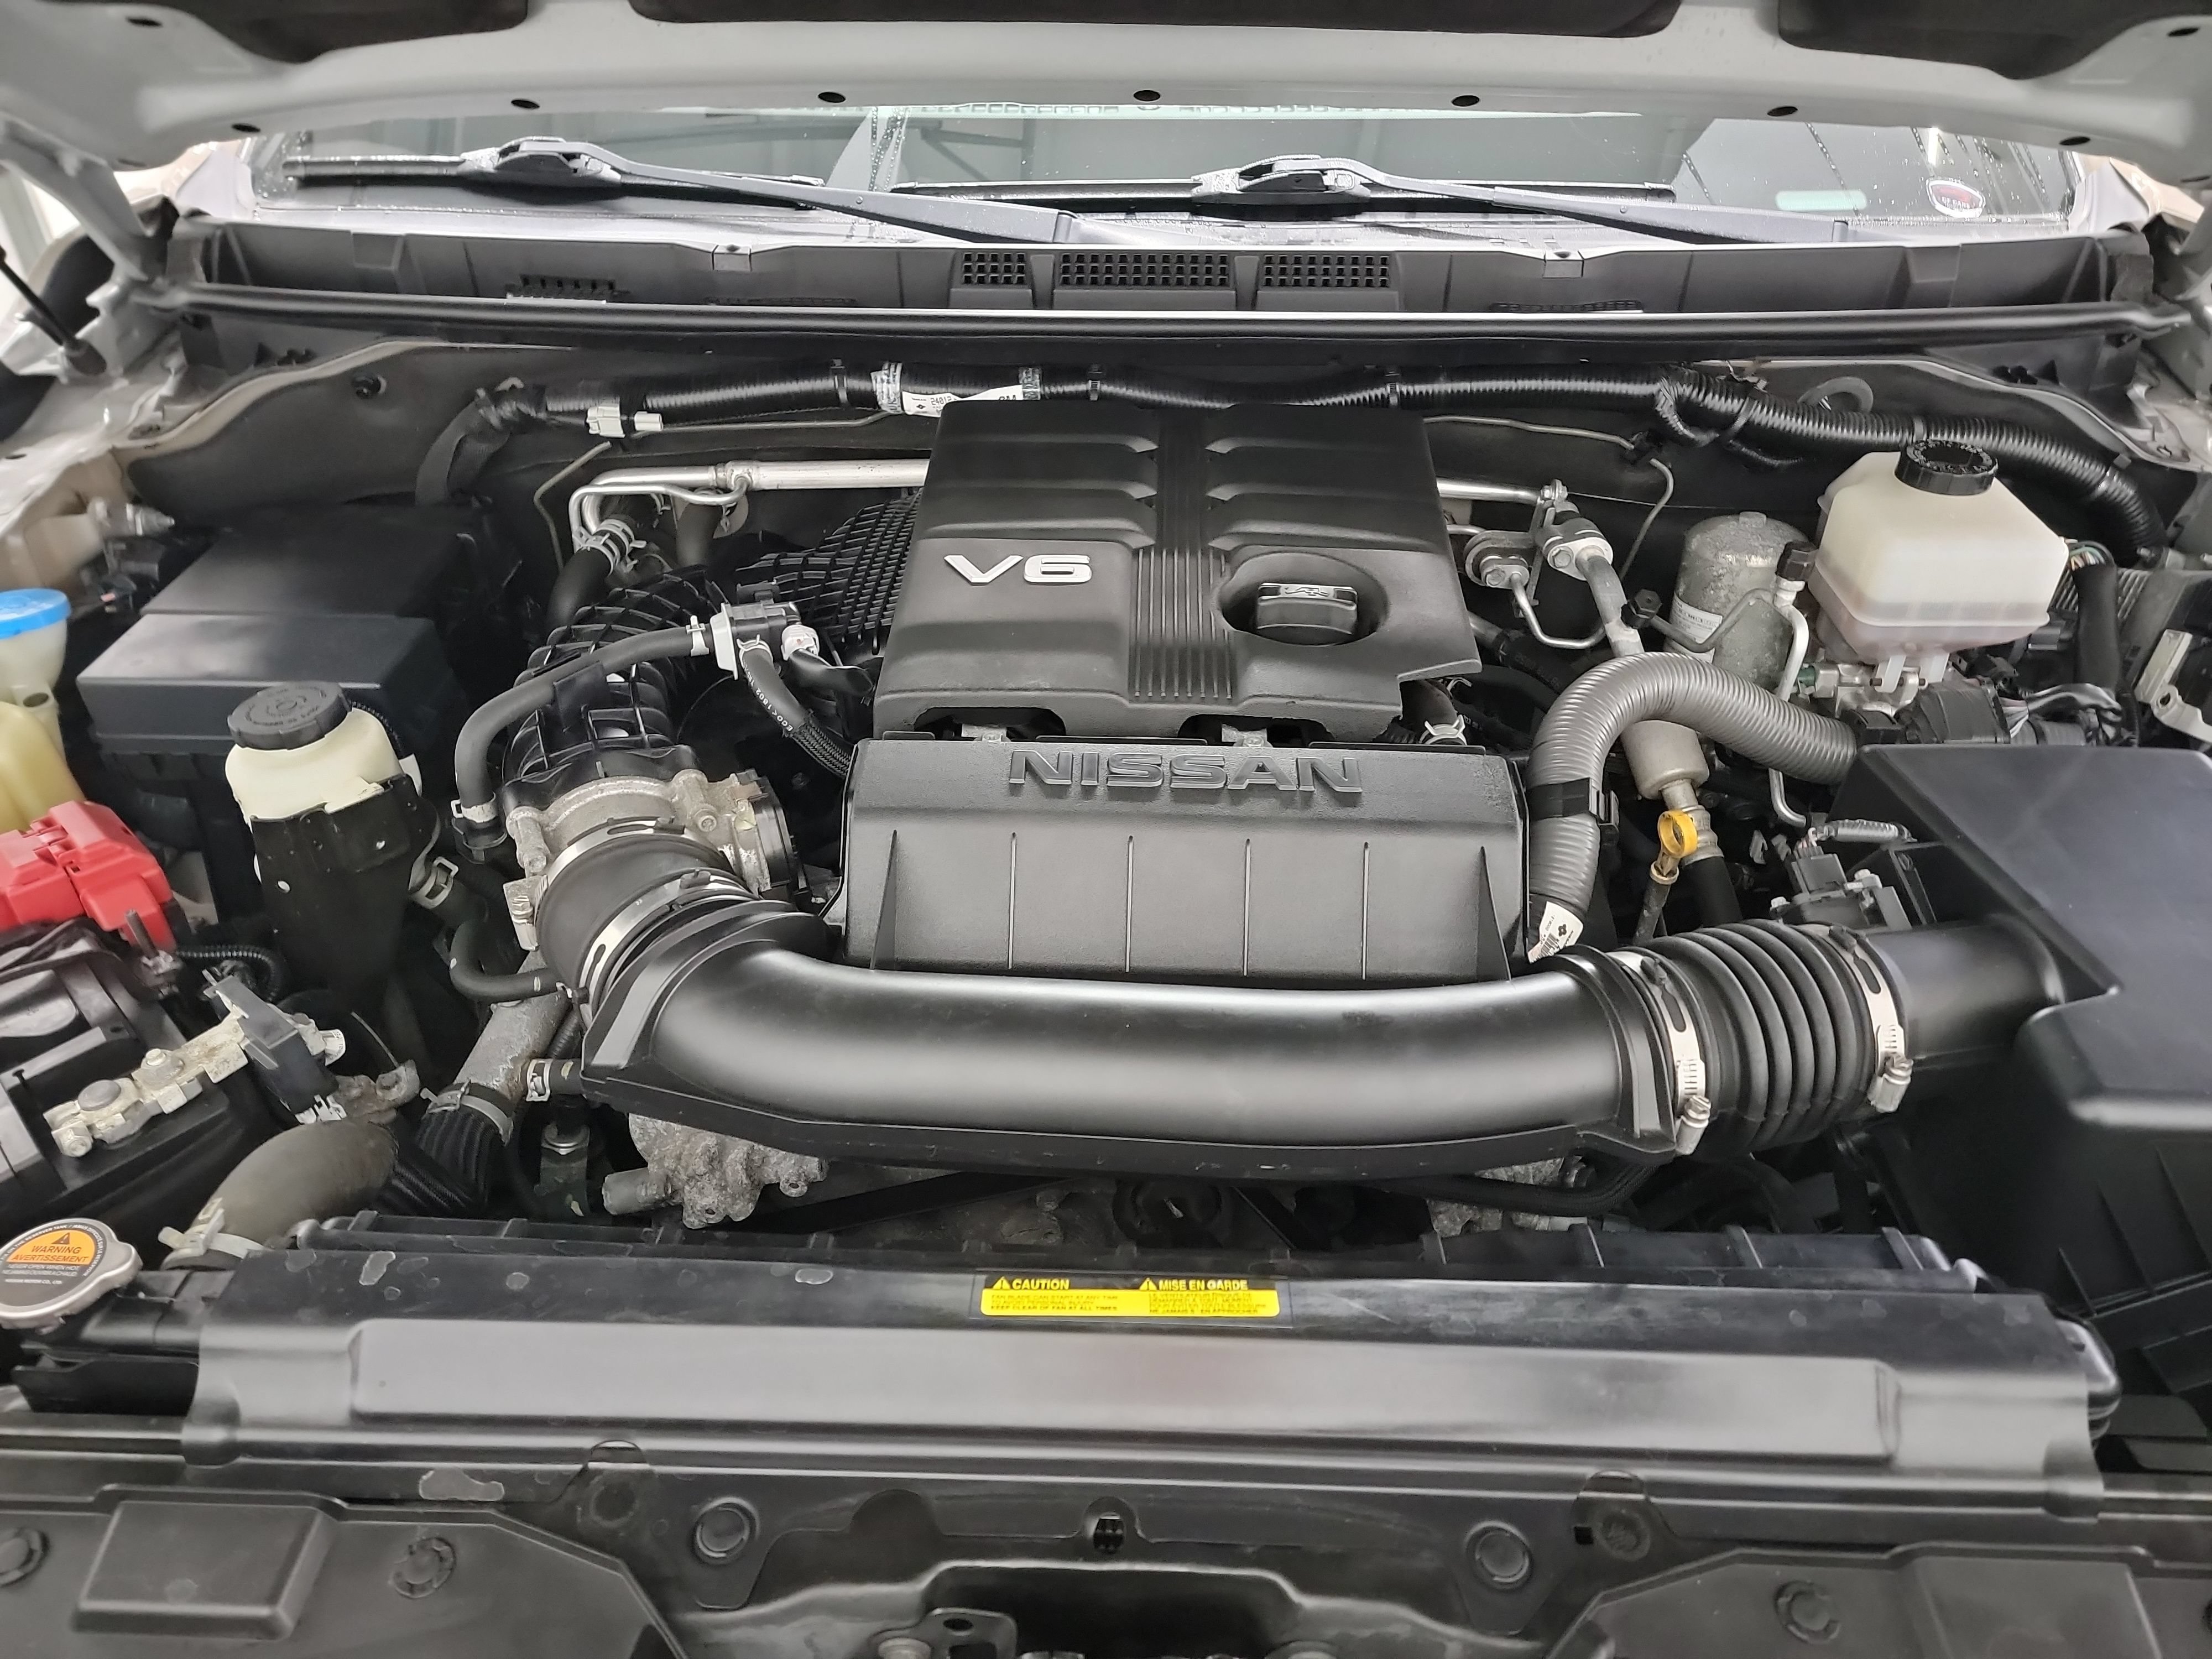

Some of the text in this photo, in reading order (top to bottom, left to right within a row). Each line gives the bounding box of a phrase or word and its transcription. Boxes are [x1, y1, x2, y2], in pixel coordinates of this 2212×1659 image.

[943, 554, 1092, 586] V6
[1009, 750, 1363, 792] NISSAN
[31, 1245, 82, 1254] WARNING
[12, 1254, 90, 1262] AVERTISSEMENT
[1012, 1279, 1070, 1290] CAUTION
[1159, 1279, 1249, 1291] MISE EN GARDE
